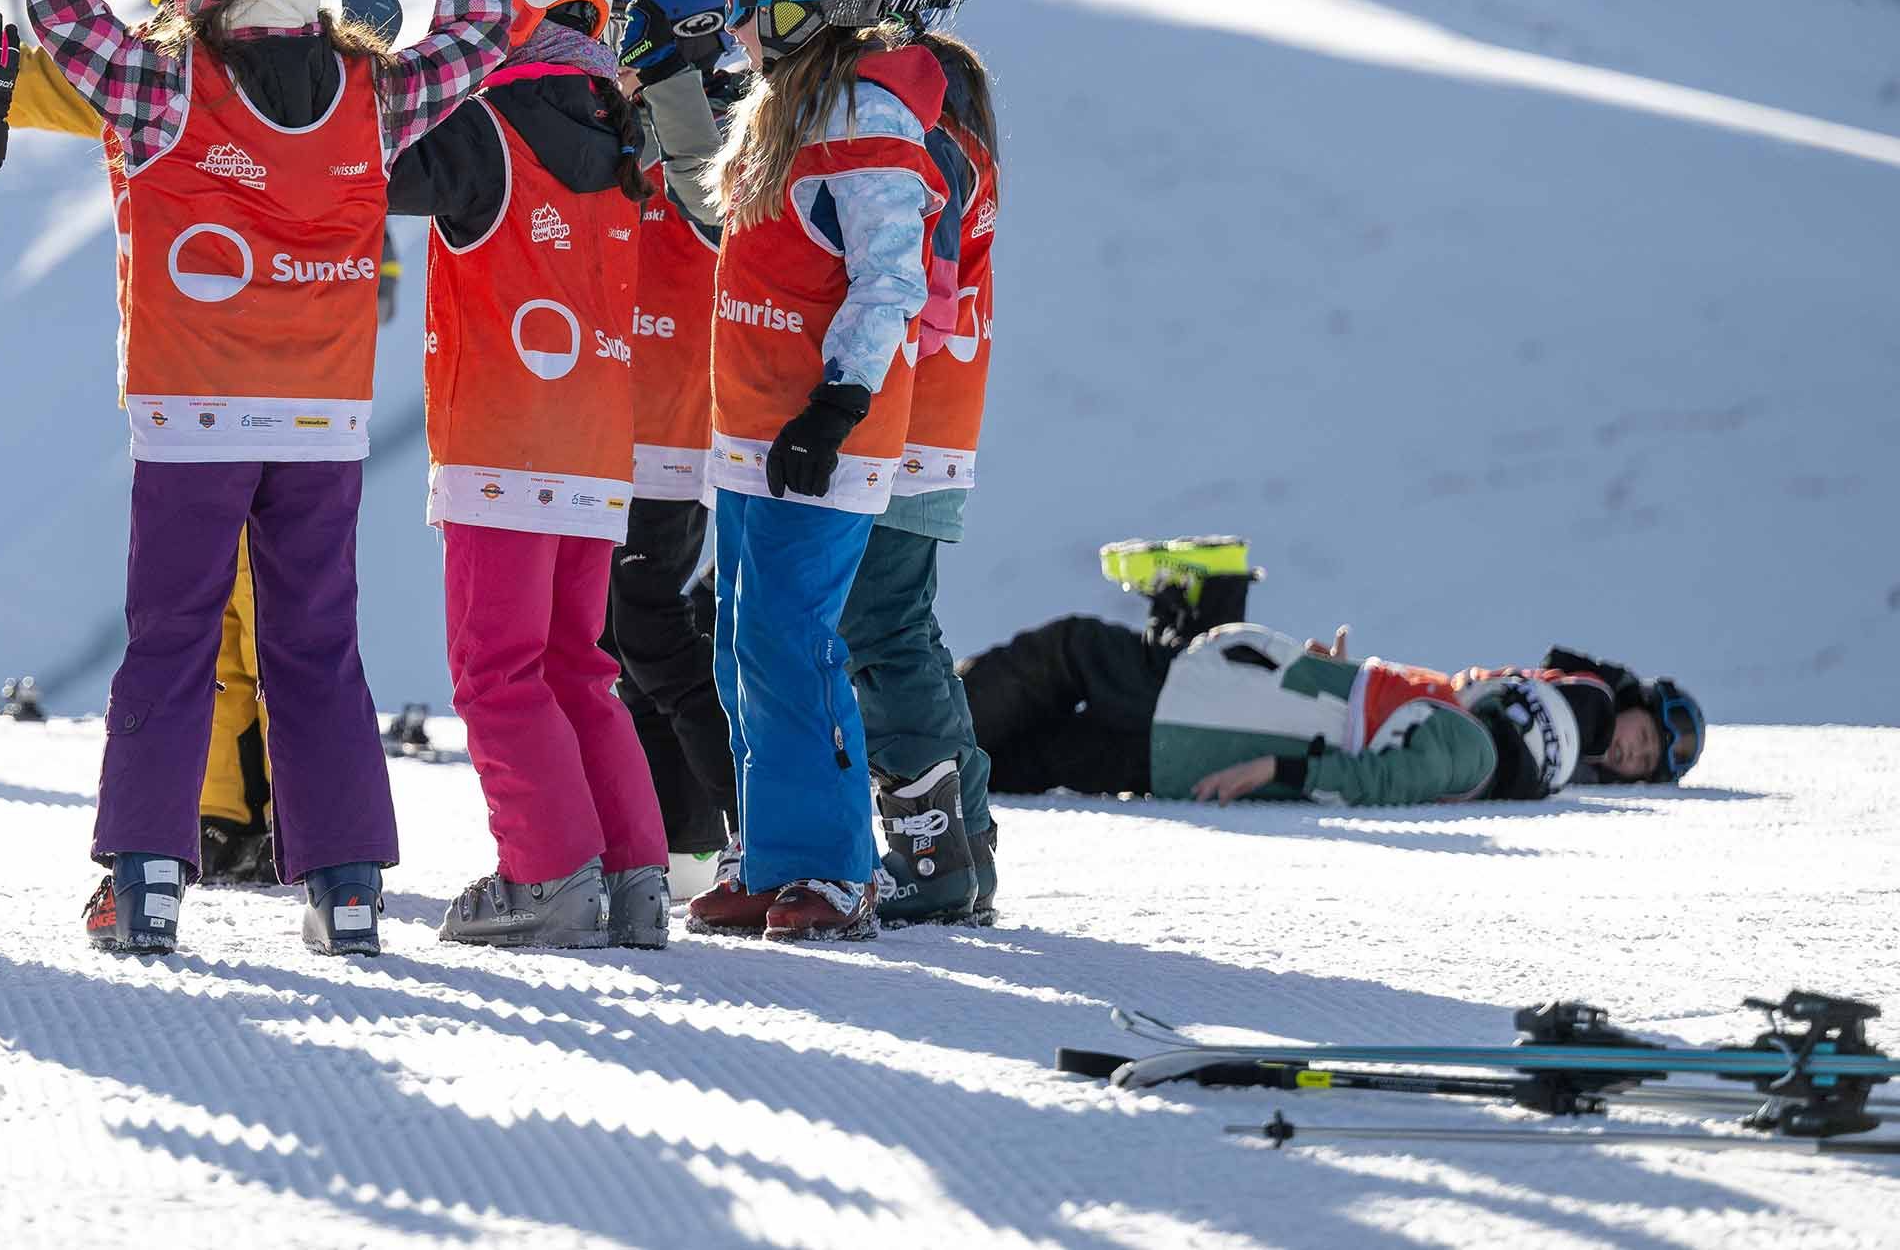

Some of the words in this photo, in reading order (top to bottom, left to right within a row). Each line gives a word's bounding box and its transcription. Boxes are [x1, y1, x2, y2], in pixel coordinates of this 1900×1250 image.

[620, 39, 653, 66] reusch
[208, 155, 251, 166] Sunrise
[235, 165, 266, 177] Days
[329, 162, 368, 176] swissski
[718, 290, 804, 334] Sunrise
